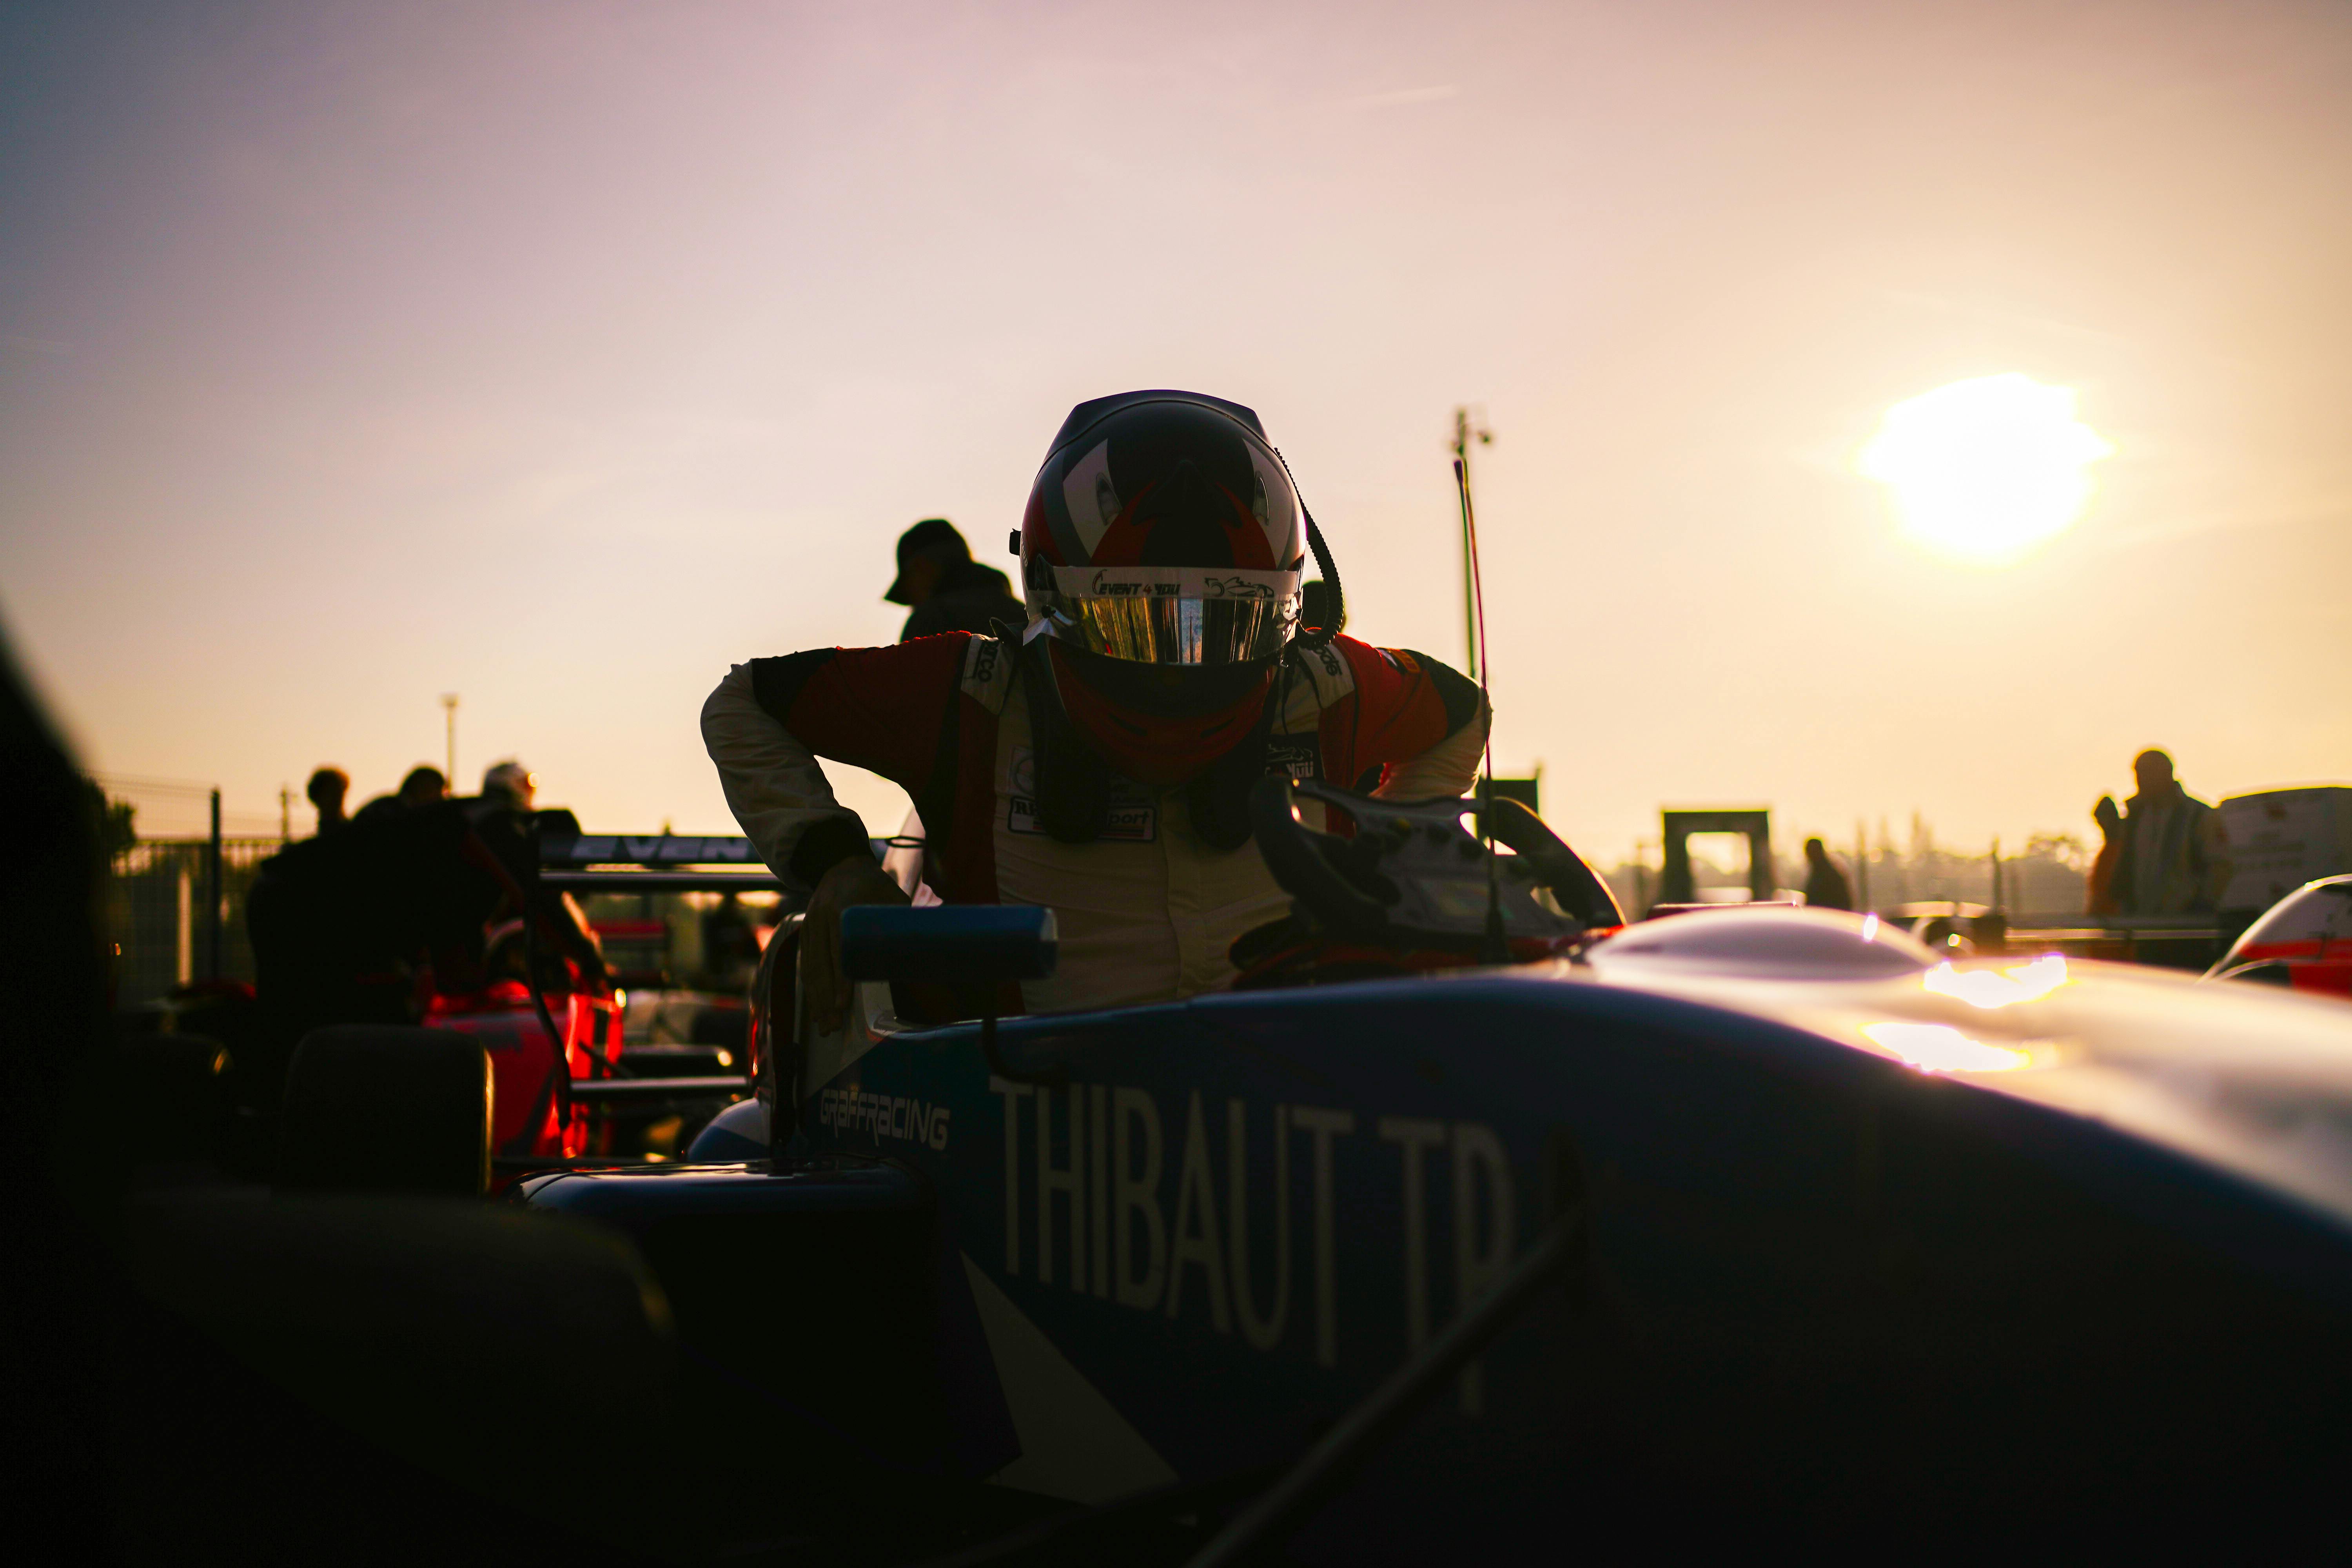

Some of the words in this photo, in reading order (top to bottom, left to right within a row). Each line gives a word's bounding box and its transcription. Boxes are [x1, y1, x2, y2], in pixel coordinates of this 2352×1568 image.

[1099, 583, 1142, 595] EVENT
[1143, 583, 1152, 595] 4
[1154, 583, 1181, 595] YOU
[1108, 811, 1150, 826] port
[989, 1075, 1356, 1369] THIBAUT
[1377, 1115, 1519, 1418] TP
